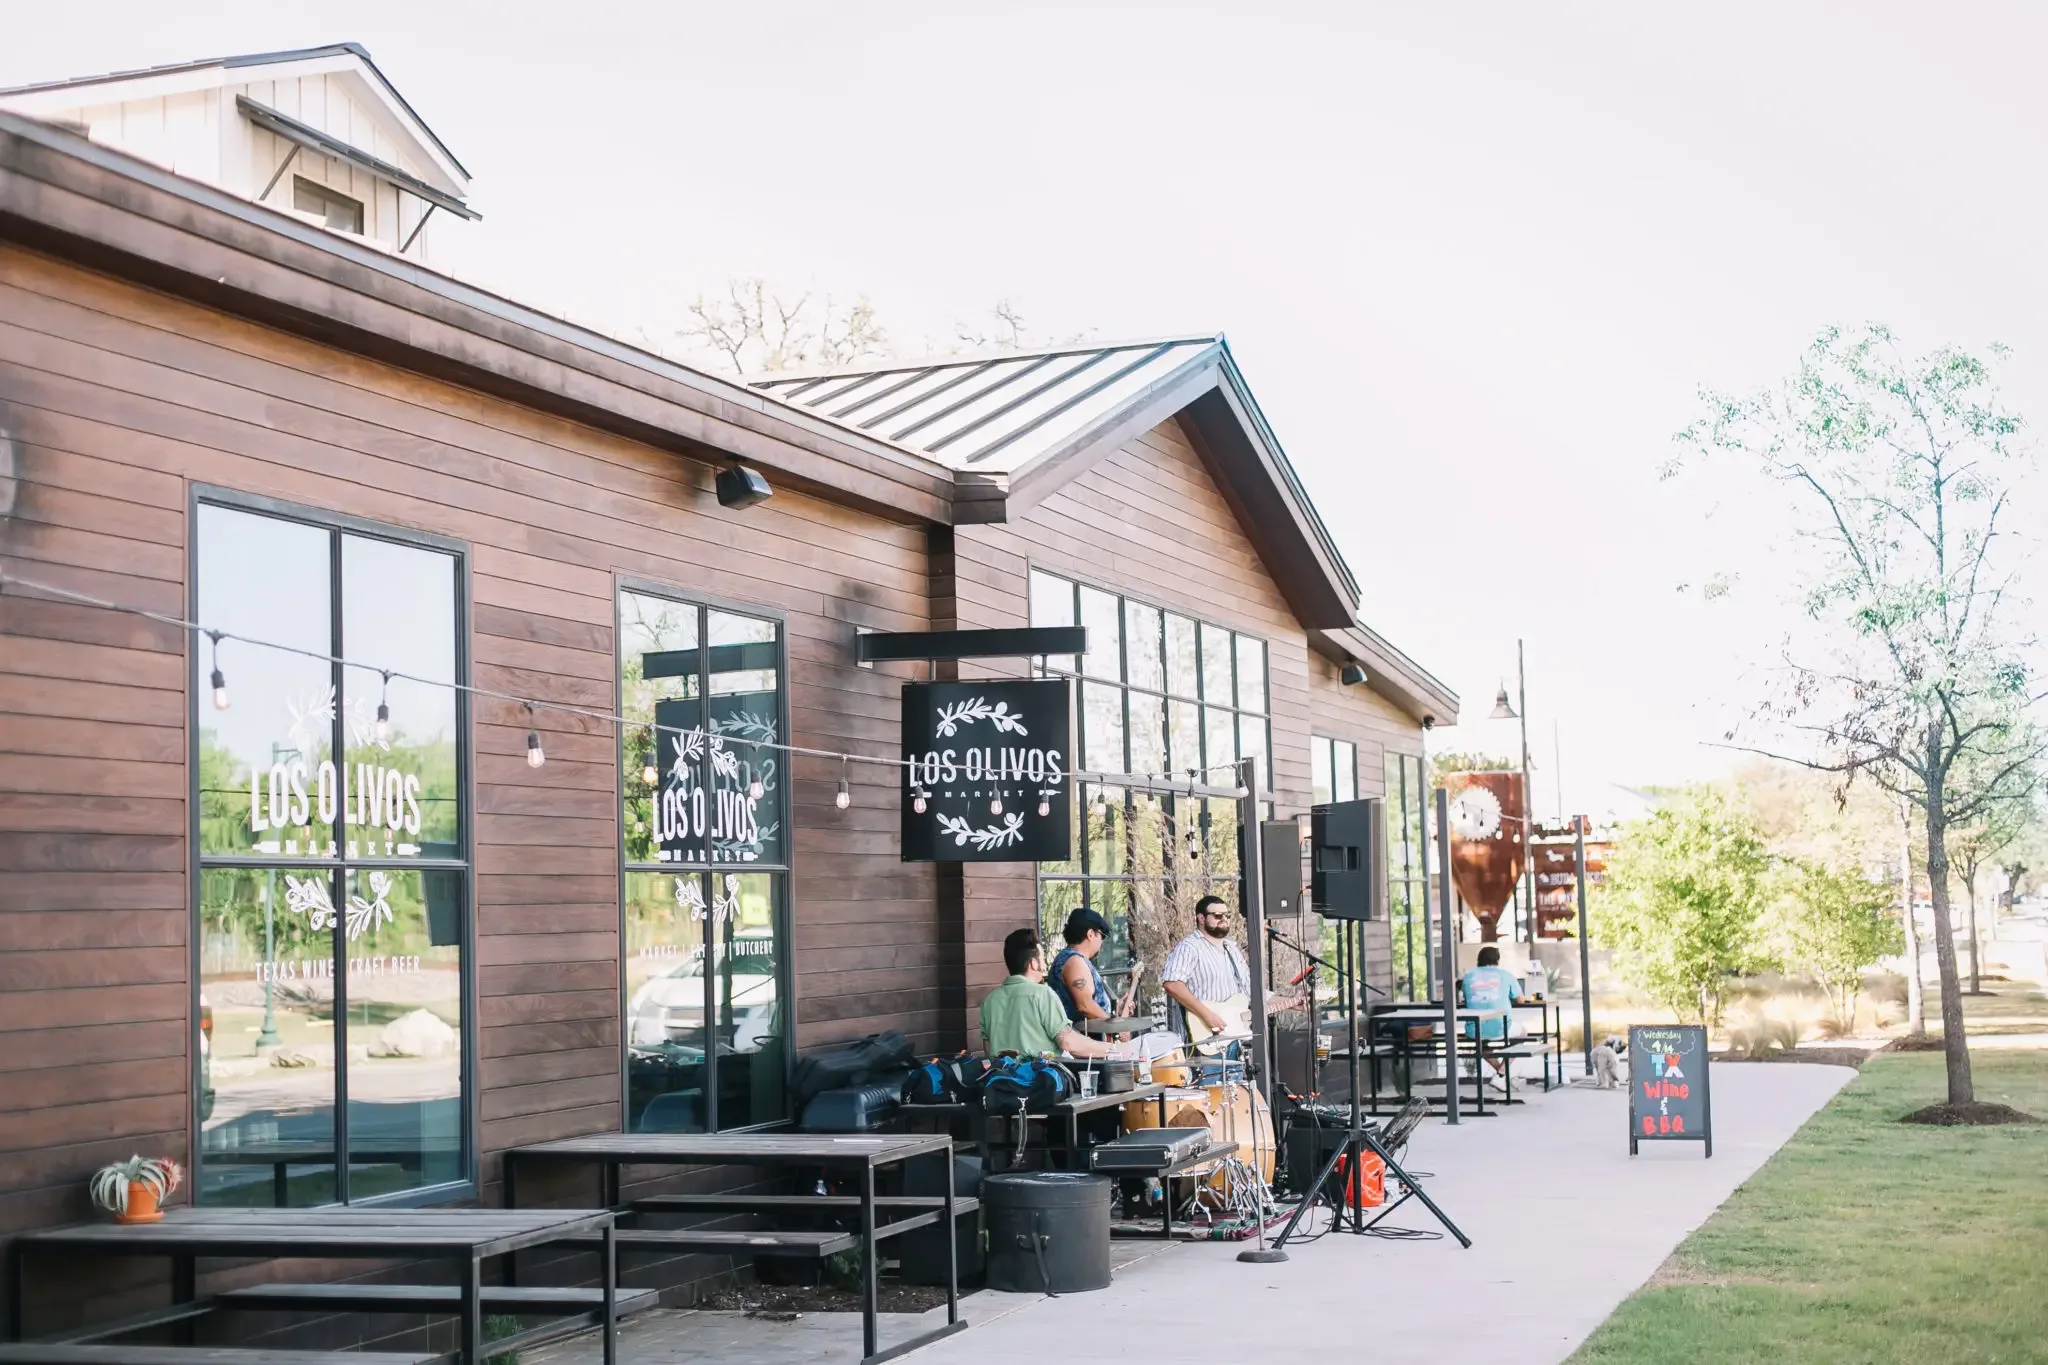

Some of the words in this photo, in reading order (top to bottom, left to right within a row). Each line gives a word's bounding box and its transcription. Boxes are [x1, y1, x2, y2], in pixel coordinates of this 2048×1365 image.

[910, 749, 957, 787] LOS
[966, 747, 1062, 784] OLIVOS
[251, 761, 310, 832] LOS
[318, 760, 421, 835] OLIVOS
[652, 787, 689, 844] LOS
[690, 942, 727, 958] EATY
[735, 940, 773, 956] BUTCHERY
[255, 960, 296, 983] TEXAS
[302, 958, 335, 979] WINE
[349, 955, 386, 977] CRAFT
[391, 955, 420, 974] BEER
[1643, 1030, 1682, 1044] Wednesday
[1650, 1053, 1685, 1078] TX
[1643, 1079, 1689, 1099] Wine
[1643, 1114, 1685, 1135] BBQ
